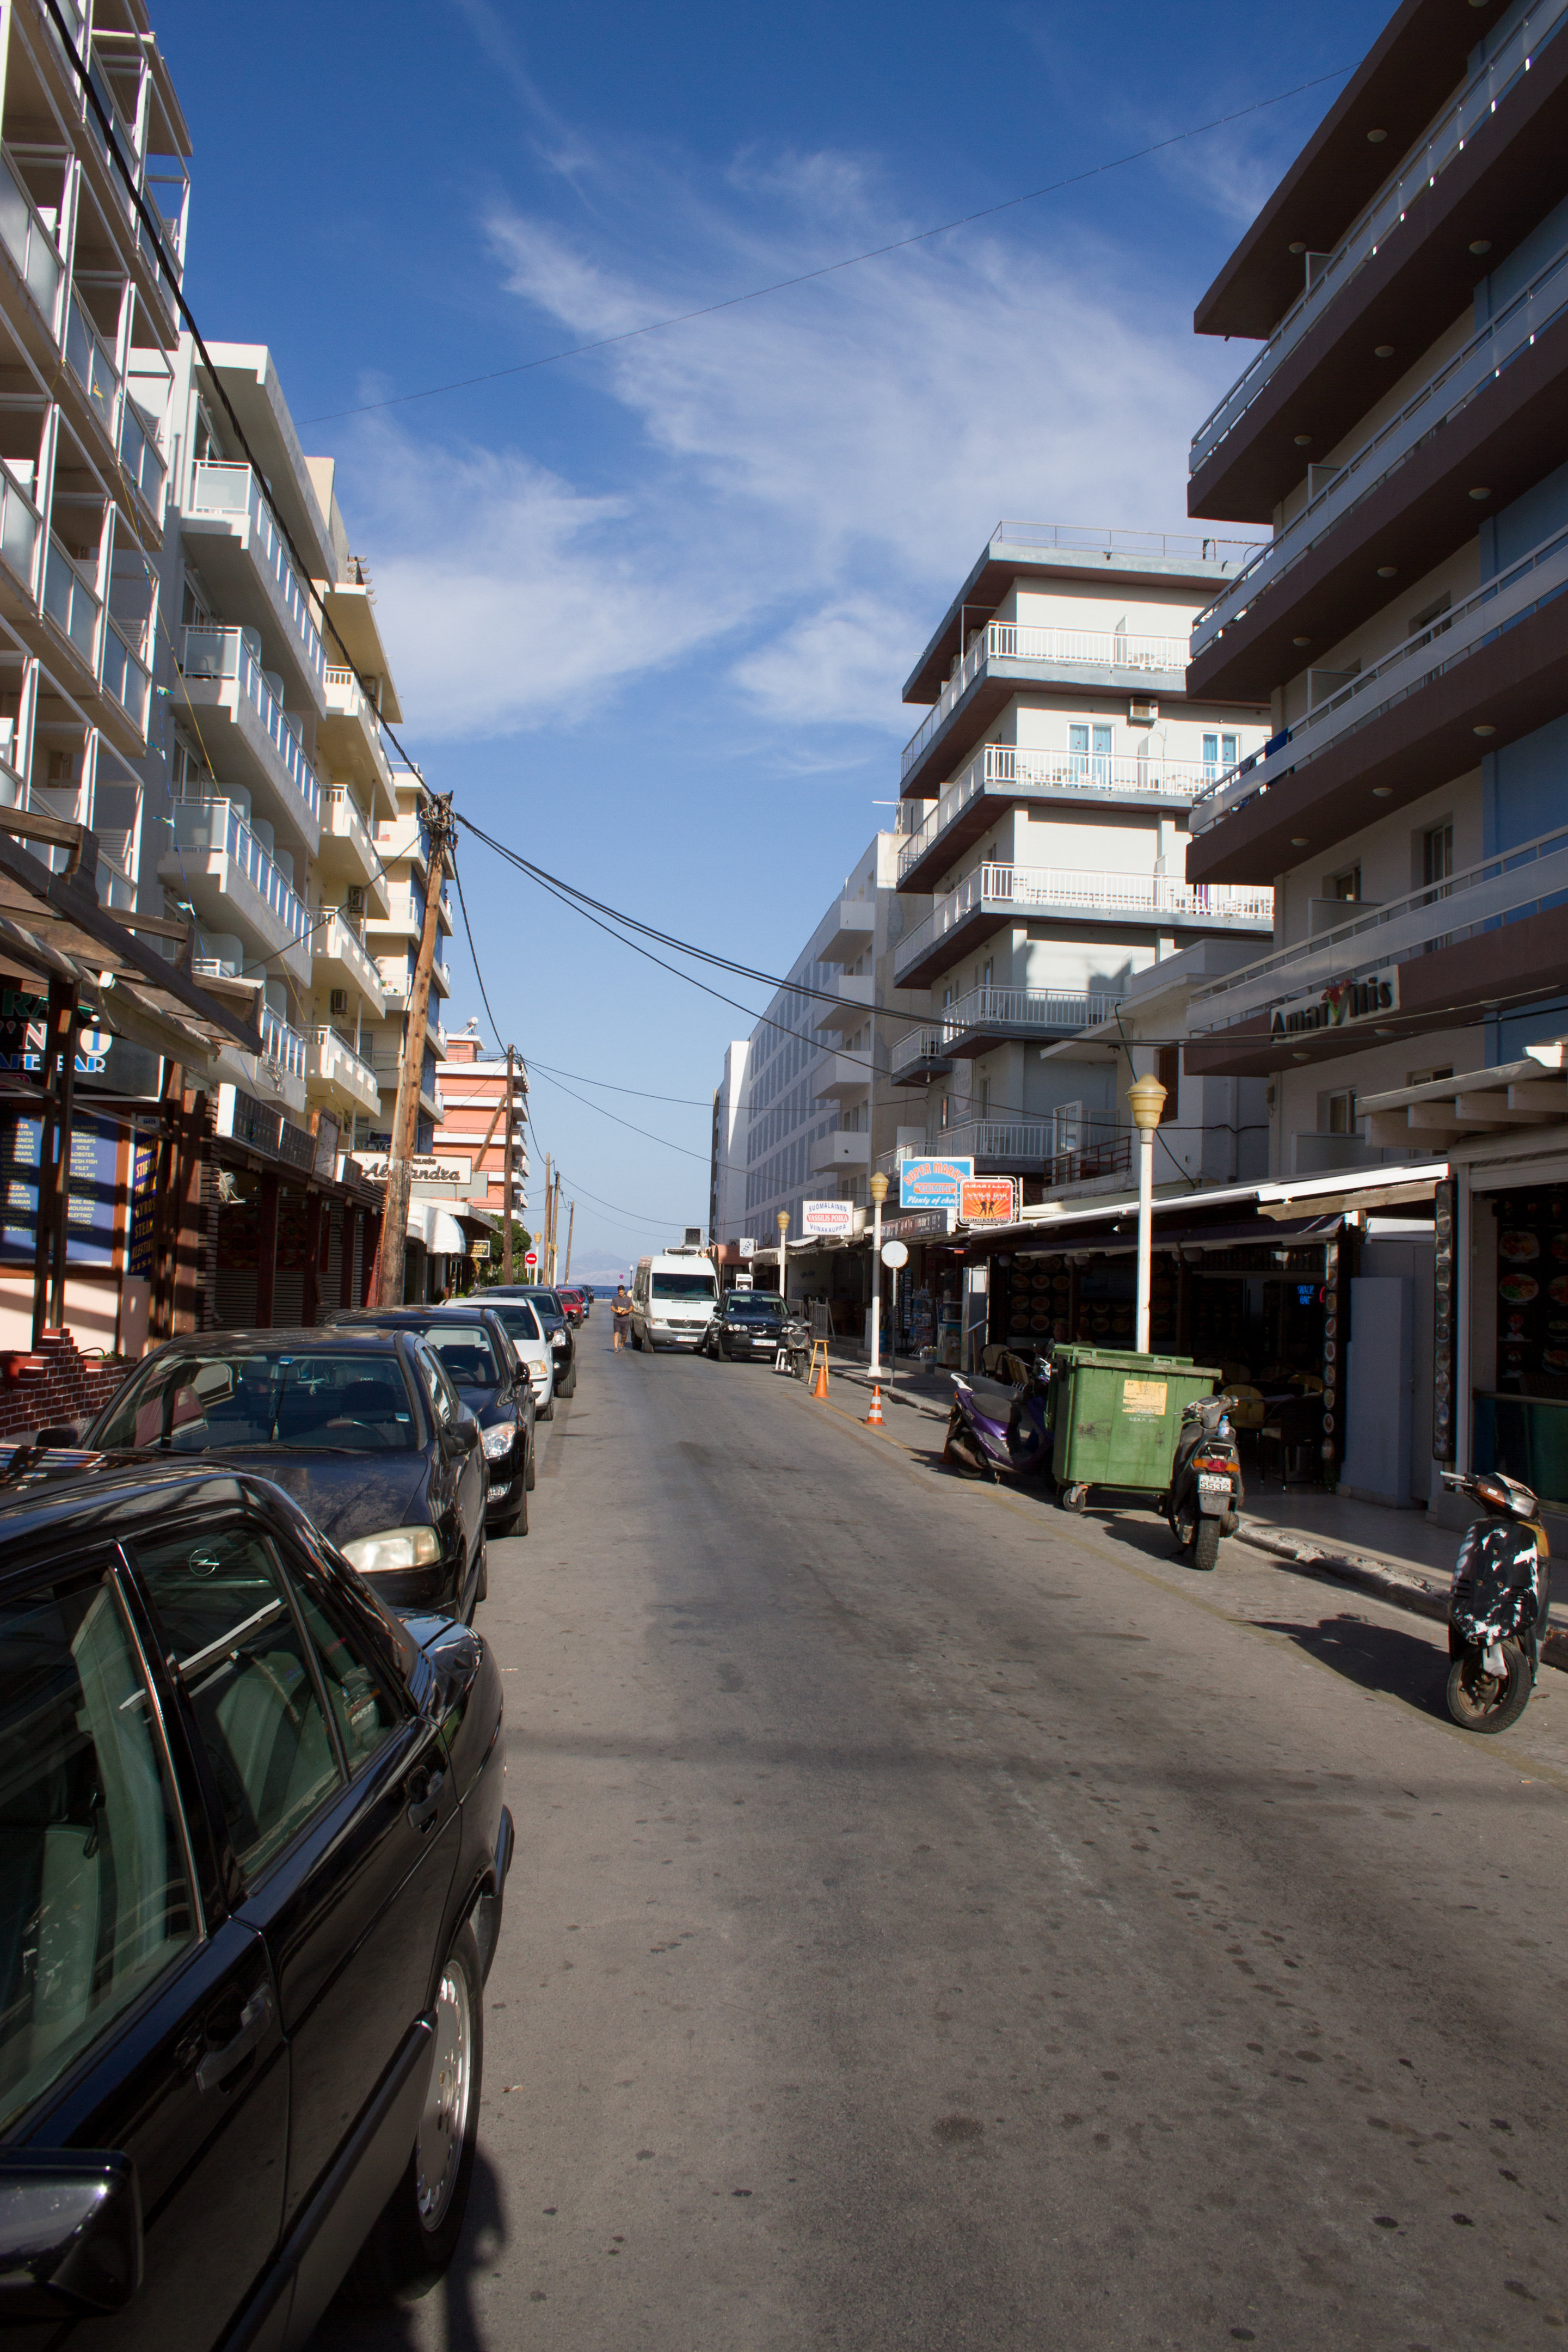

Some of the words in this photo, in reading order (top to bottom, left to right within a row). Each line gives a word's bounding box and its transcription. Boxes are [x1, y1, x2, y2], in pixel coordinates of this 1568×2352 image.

[1270, 977, 1392, 1042] Amaryllis
[903, 1163, 931, 1187] SUPER
[933, 1162, 969, 1184] MARKE
[907, 1195, 930, 1205] Plenty
[931, 1196, 940, 1205] of
[941, 1196, 961, 1204] choic
[809, 1202, 847, 1212] SUOMALAINEN
[810, 1223, 847, 1233] VIINAKAUPPA
[1200, 1481, 1229, 1491] 5532
